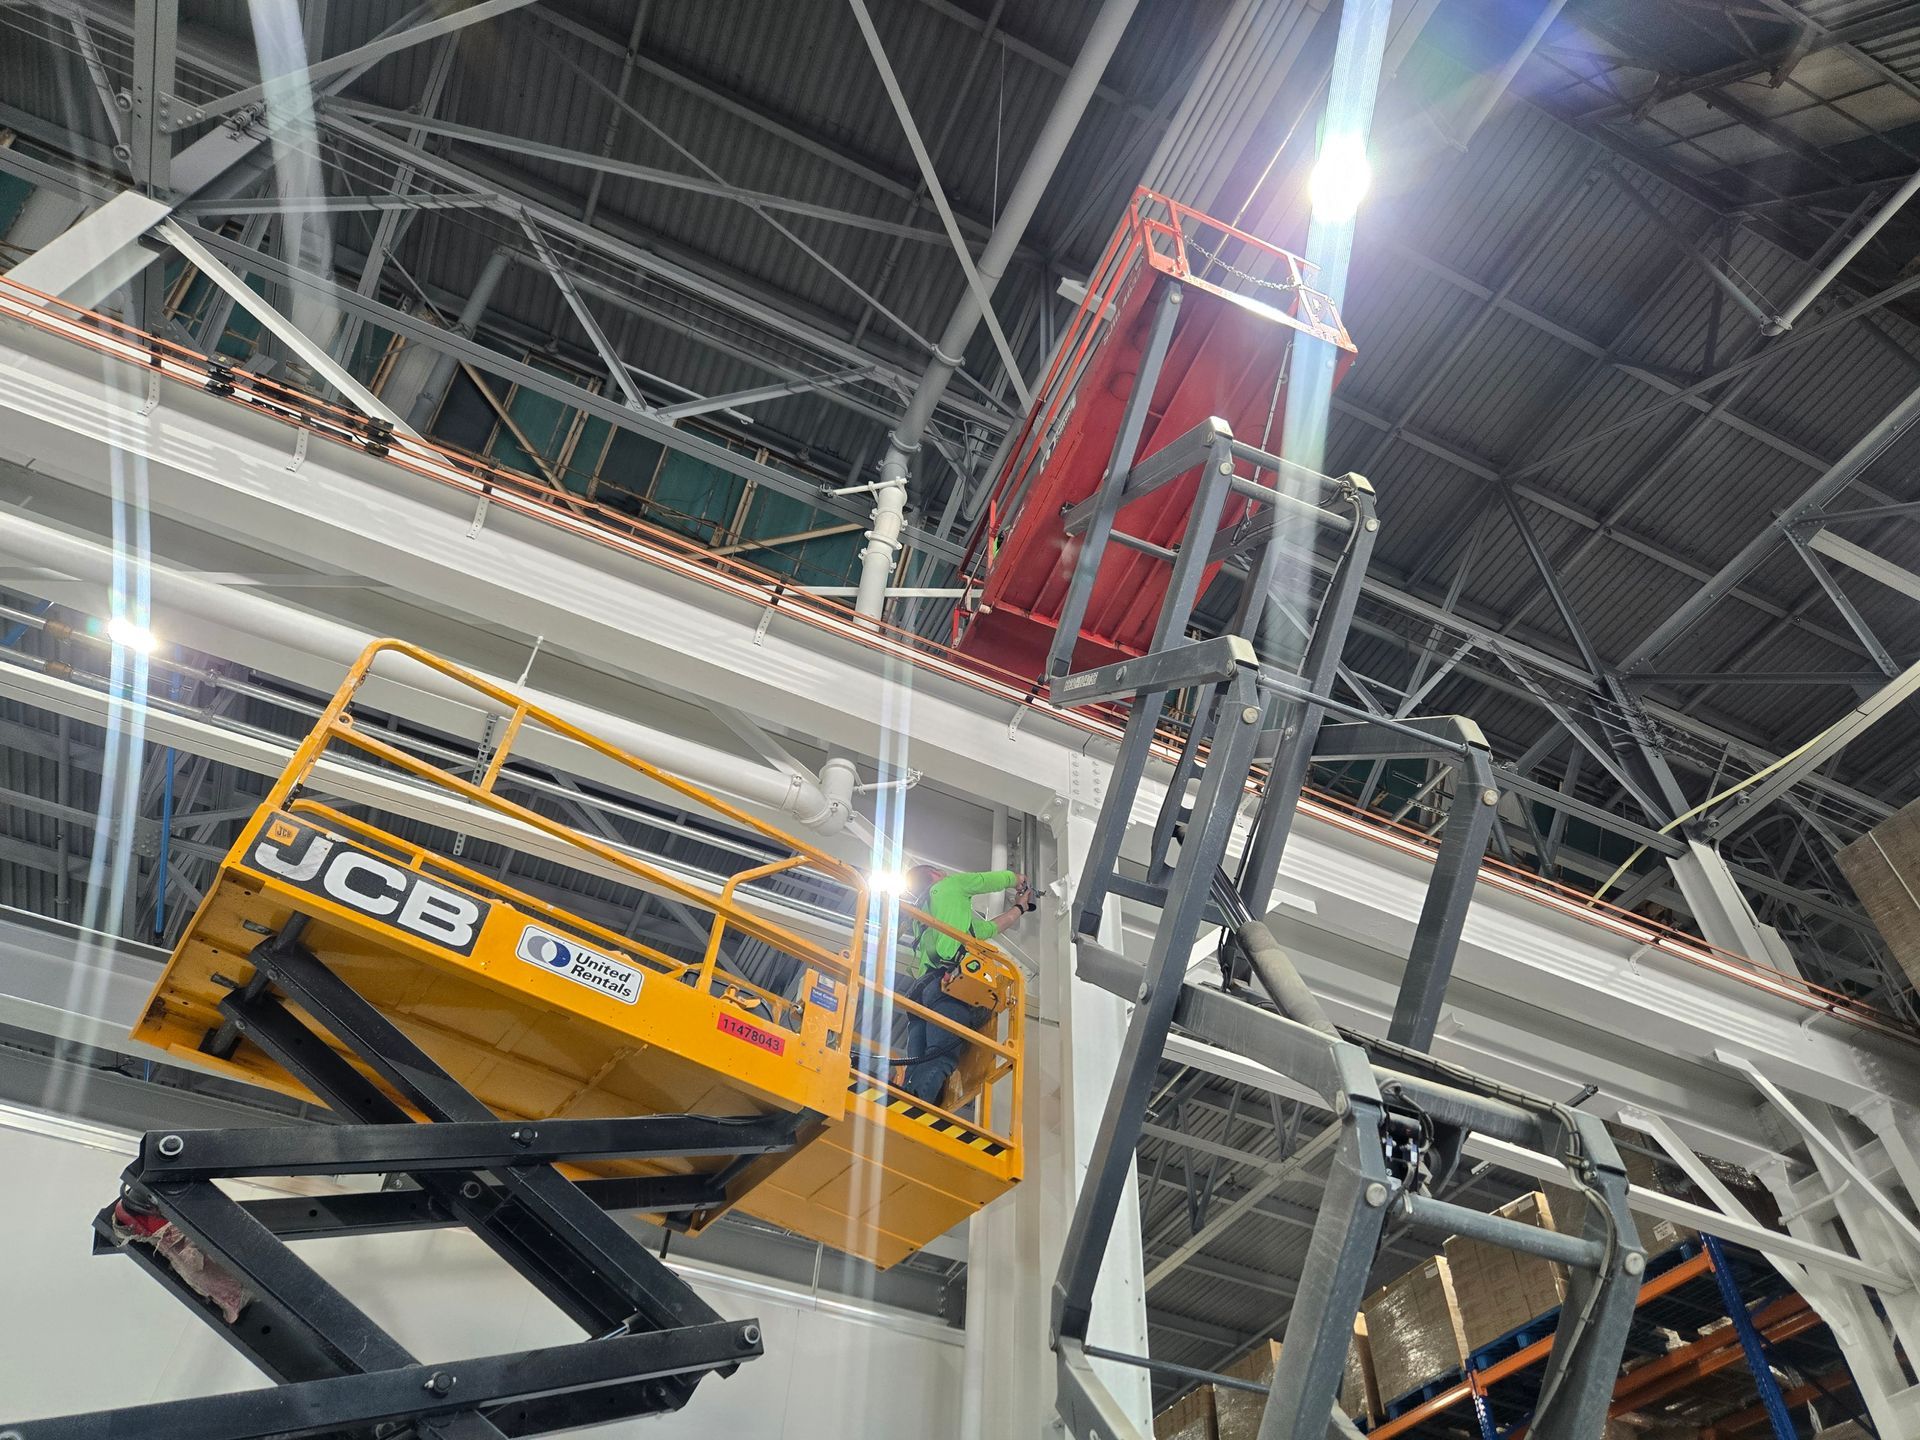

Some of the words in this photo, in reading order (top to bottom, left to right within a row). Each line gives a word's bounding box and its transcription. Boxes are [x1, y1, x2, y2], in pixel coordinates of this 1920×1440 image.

[254, 835, 479, 946] JCB
[570, 964, 632, 997] Rentals
[575, 952, 631, 983] United
[723, 1018, 780, 1051] 11478043
